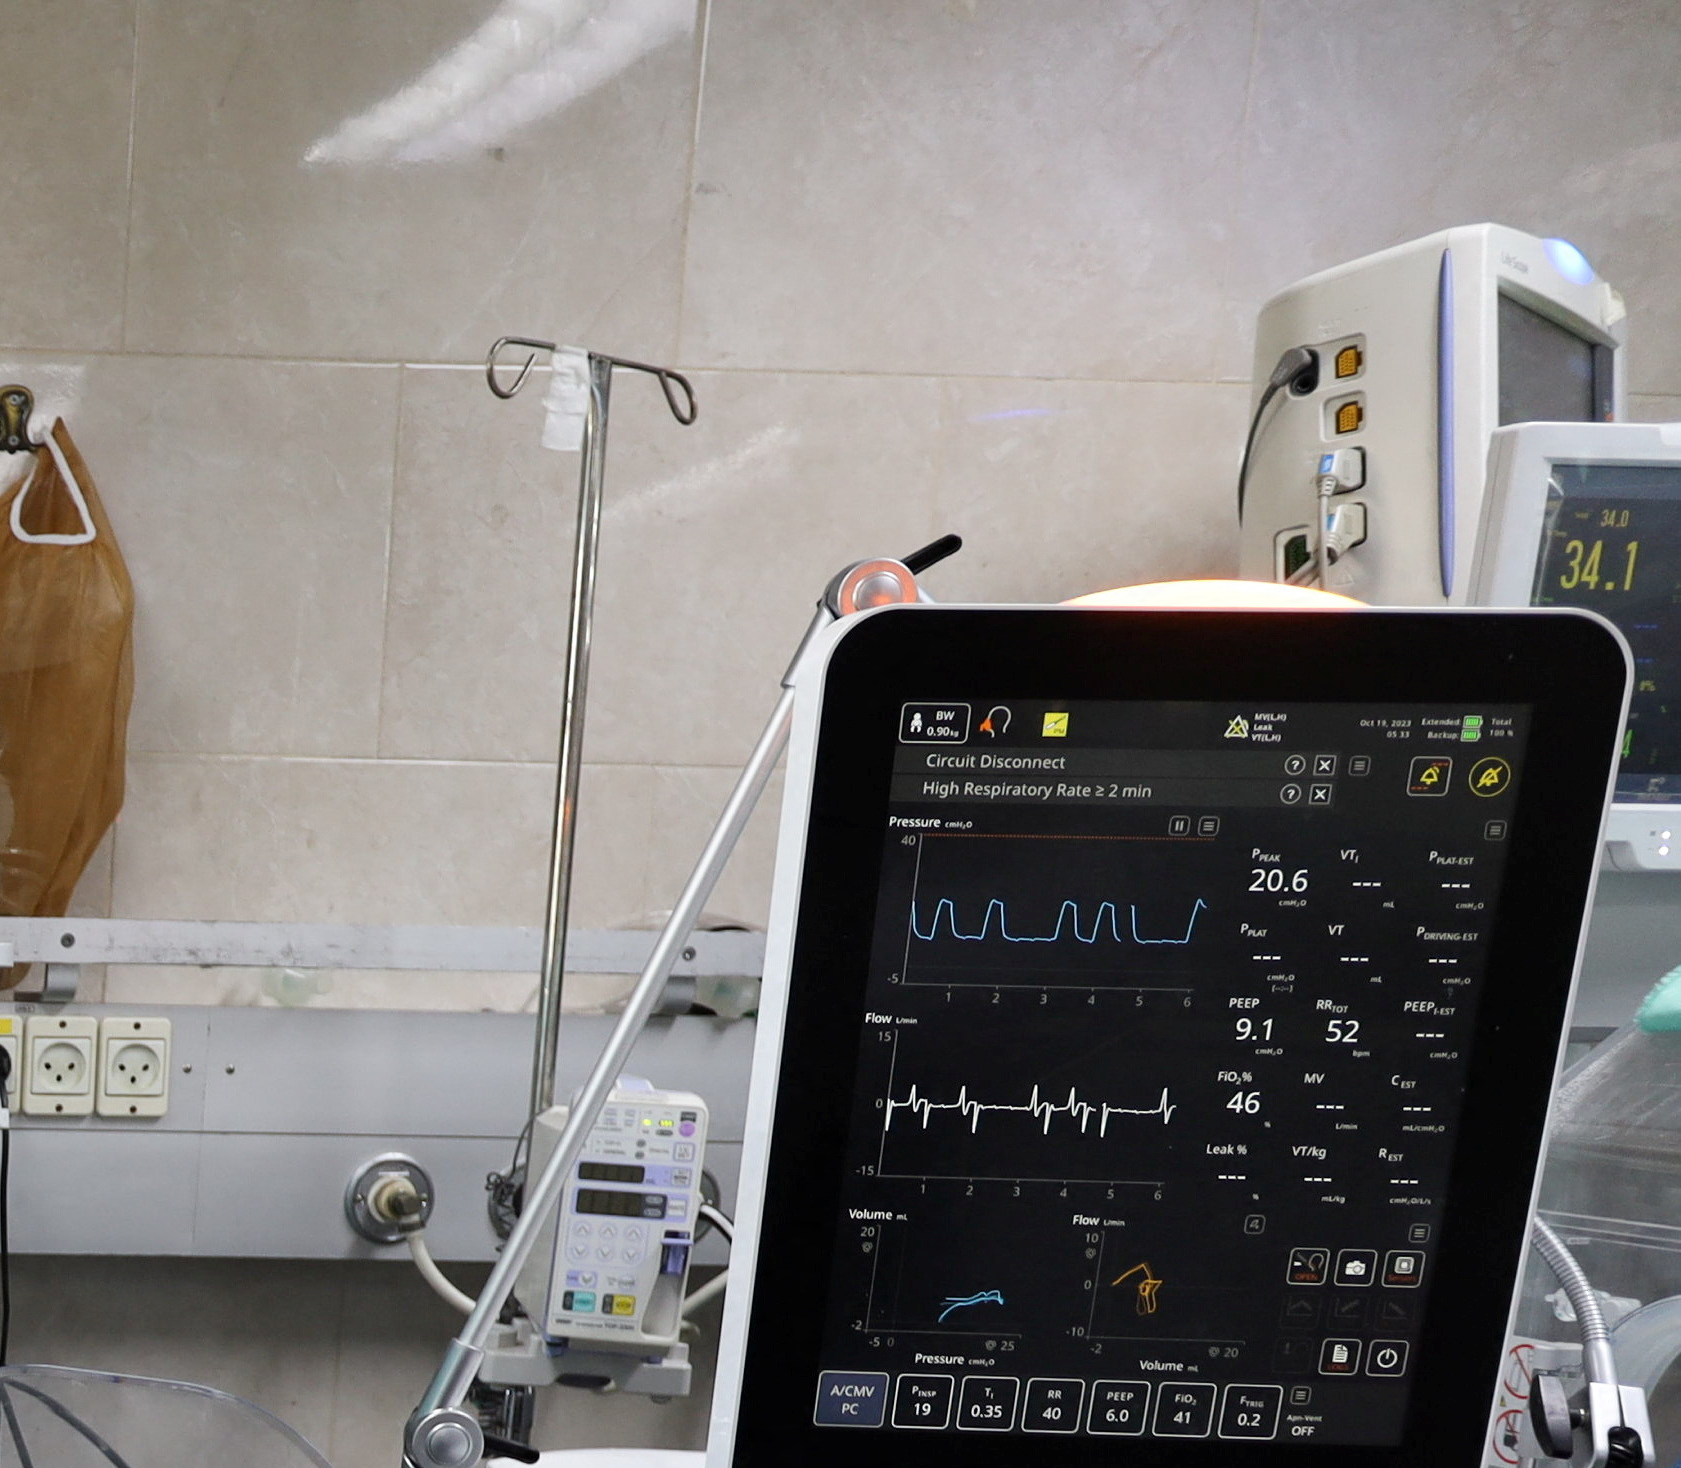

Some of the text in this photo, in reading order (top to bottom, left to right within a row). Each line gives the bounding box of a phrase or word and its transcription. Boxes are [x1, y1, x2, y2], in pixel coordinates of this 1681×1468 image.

[1601, 510, 1629, 527] 34.0
[1560, 540, 1638, 590] 34.1
[936, 712, 955, 721] BW
[1253, 723, 1272, 732] Leak
[926, 753, 1066, 770] Circuit Disconnect
[923, 781, 1152, 800] High Respiratory Rate 2 min
[889, 816, 941, 828] Pressure
[901, 835, 916, 846] 40
[1248, 869, 1308, 892] 20.6
[1328, 925, 1344, 936] VT
[1229, 998, 1259, 1009] PEEP
[865, 1013, 892, 1024] Flow
[1235, 1018, 1273, 1041] 9.1
[1325, 1020, 1359, 1043] 52
[878, 1031, 892, 1042] 15
[1304, 1074, 1325, 1084] MV
[1226, 1092, 1261, 1114] 46
[1206, 1144, 1234, 1155] Leak
[1292, 1146, 1326, 1160] VT/kg
[856, 1165, 874, 1176] -15
[849, 1209, 892, 1220] Volume
[1072, 1215, 1100, 1226] Flow
[860, 1227, 874, 1237] 20
[1001, 1341, 1015, 1351] 25
[915, 1353, 965, 1365] Pressure
[1139, 1361, 1184, 1372] Volume
[830, 1385, 875, 1397] A/CMV
[1047, 1389, 1062, 1399] RR
[1107, 1391, 1134, 1401] PEEP
[842, 1403, 859, 1415] PC
[914, 1403, 931, 1416] 19
[971, 1405, 1002, 1418] 0.35
[1042, 1407, 1061, 1420] 40
[1105, 1409, 1129, 1422] 6.0
[1173, 1411, 1192, 1424] 41
[1237, 1413, 1260, 1427] 0.2
[1291, 1426, 1315, 1436] OFF
